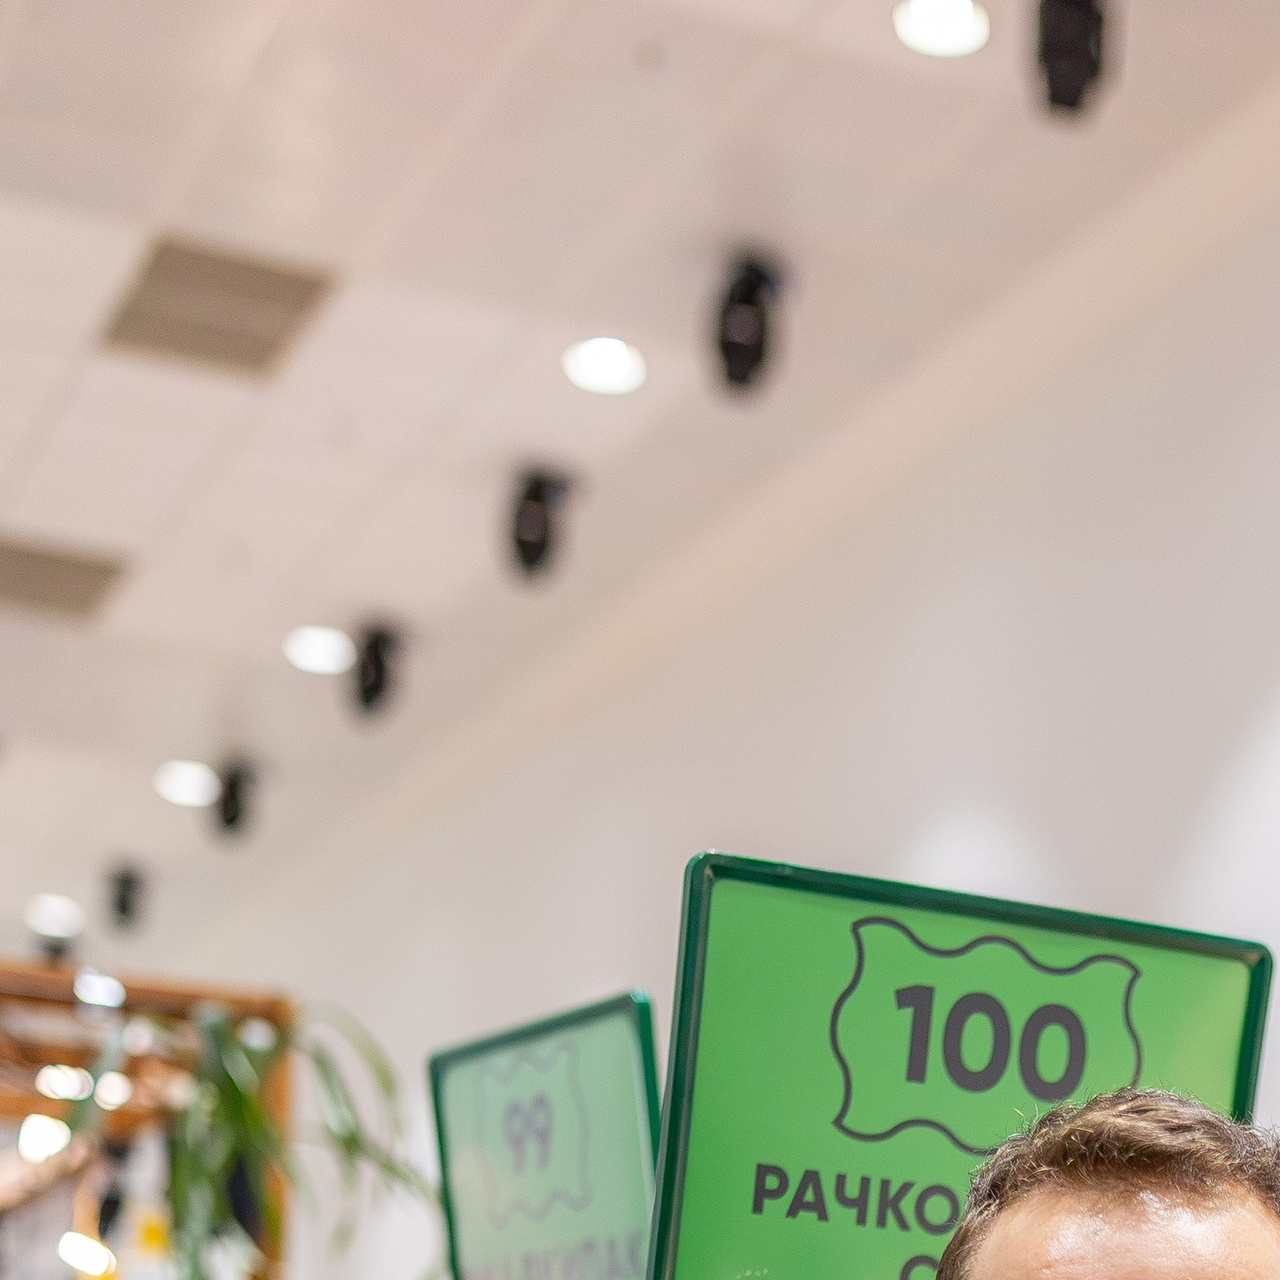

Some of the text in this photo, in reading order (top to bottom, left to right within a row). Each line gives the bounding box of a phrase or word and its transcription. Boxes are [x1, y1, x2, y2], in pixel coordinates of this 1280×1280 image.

[895, 984, 1085, 1103] 100
[503, 1093, 551, 1174] 99
[752, 1163, 960, 1235] РАЧКО
